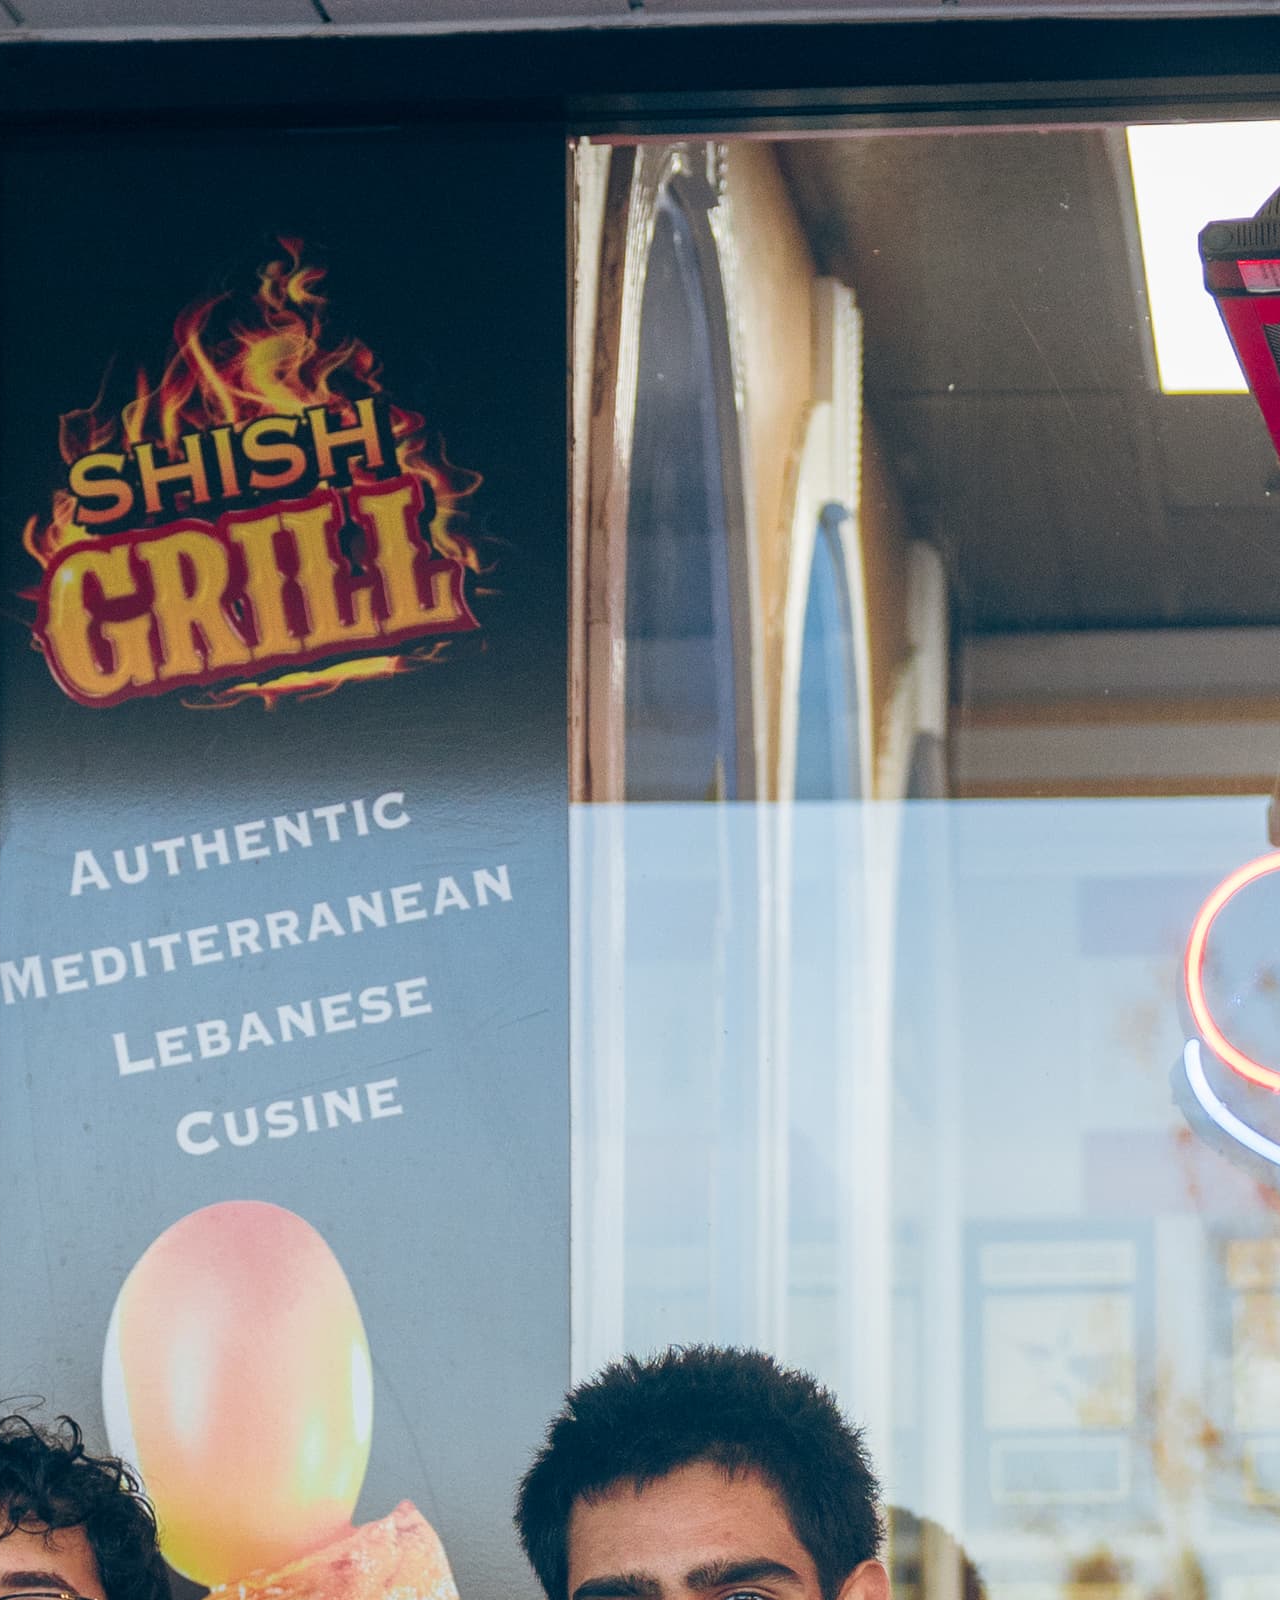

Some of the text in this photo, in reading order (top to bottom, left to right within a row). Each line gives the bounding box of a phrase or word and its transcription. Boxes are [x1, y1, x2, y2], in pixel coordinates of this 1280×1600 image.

[68, 398, 385, 524] SHISH
[38, 478, 475, 705] GRILL
[70, 792, 412, 897] AUTHENTIC
[0, 865, 514, 1005] MEDITERRANEAN
[113, 977, 434, 1075] LEBANESE
[176, 1078, 404, 1155] CUSINE
